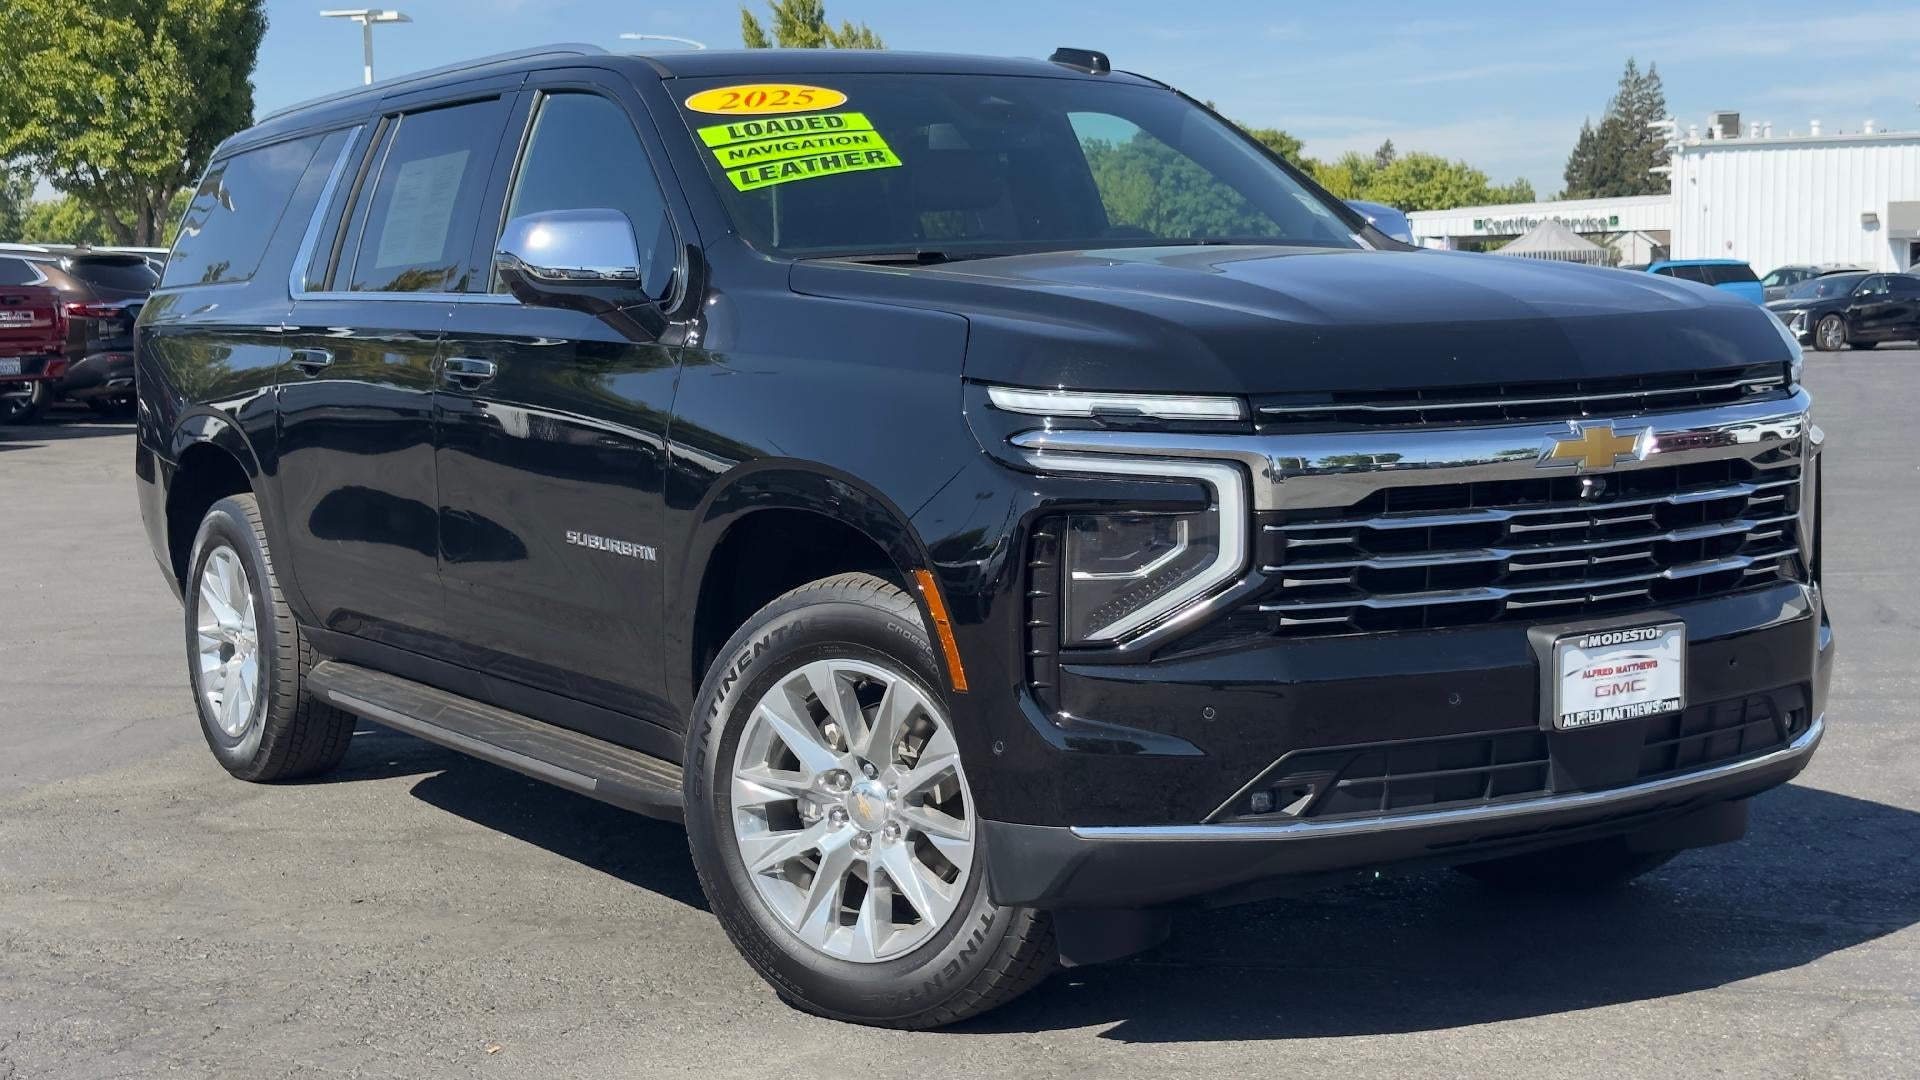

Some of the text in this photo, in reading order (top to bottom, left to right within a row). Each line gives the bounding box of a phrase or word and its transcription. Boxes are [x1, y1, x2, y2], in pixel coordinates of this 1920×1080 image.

[718, 89, 816, 110] 2025
[728, 115, 845, 139] LOADED
[729, 135, 869, 160] NAVIGATION
[740, 151, 886, 185] LEATHER
[1553, 215, 1607, 227] Service
[566, 530, 656, 561] SUBURBAN
[1588, 628, 1656, 648] MODESTO
[1582, 667, 1613, 679] ALFRED
[1616, 660, 1658, 674] MATTHEWS
[1595, 679, 1647, 697] GMC
